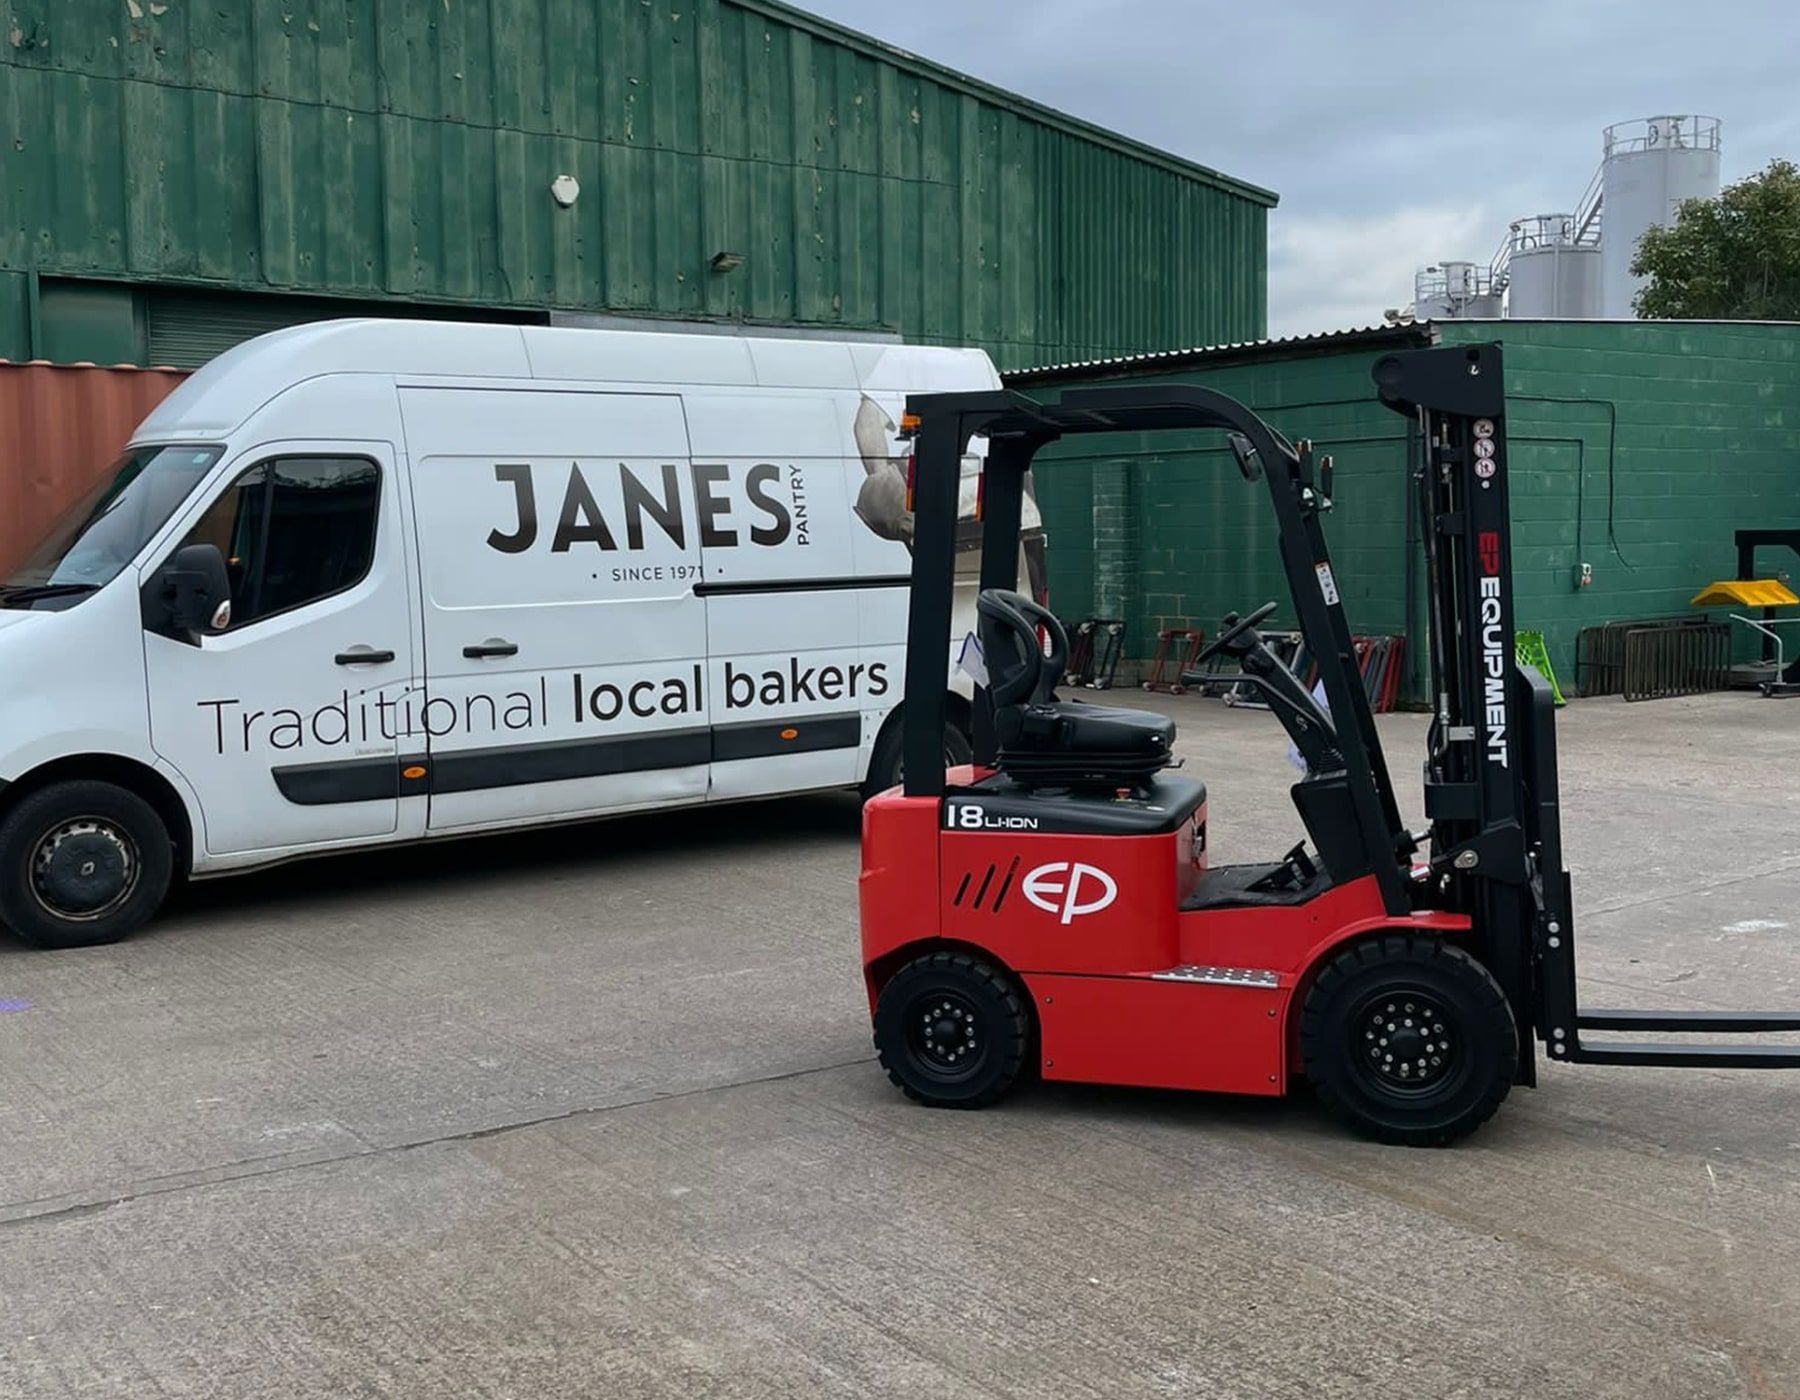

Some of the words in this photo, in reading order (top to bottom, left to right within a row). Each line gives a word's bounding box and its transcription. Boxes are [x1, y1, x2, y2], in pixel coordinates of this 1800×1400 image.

[486, 460, 792, 554] JANES
[788, 463, 810, 546] PANTRY
[612, 568, 663, 582] SINCE
[1478, 531, 1499, 575] EP
[197, 676, 548, 754] Traditional
[573, 664, 703, 724] local
[725, 656, 889, 709] bakers
[1480, 576, 1509, 770] EQUIPMENT
[947, 804, 985, 829] 18
[1021, 861, 1118, 925] EP
